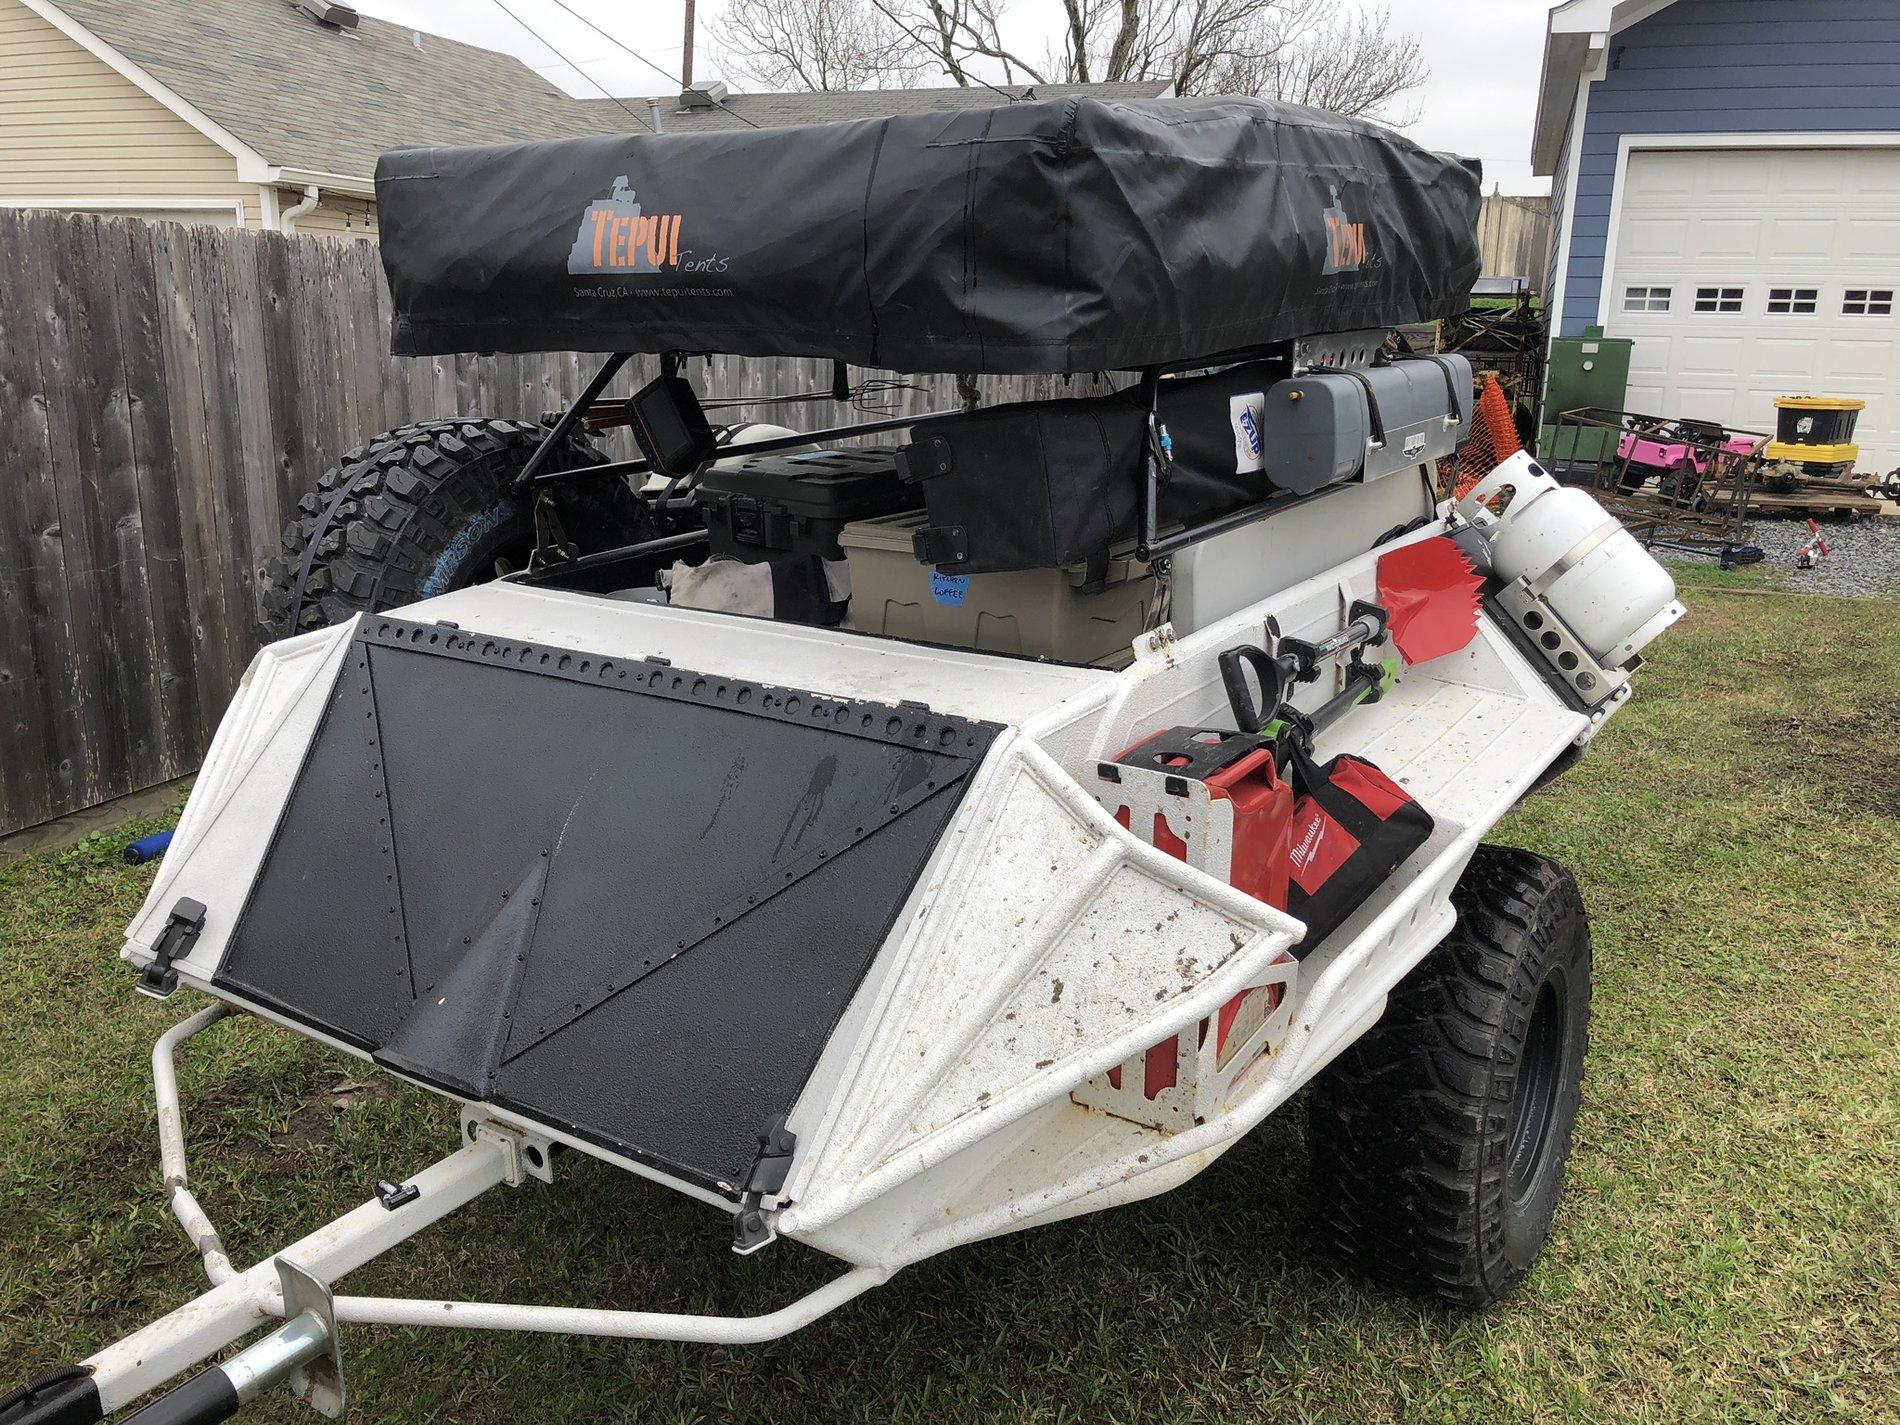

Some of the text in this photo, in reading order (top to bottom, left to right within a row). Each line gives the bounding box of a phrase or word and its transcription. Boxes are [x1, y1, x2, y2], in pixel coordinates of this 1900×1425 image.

[591, 210, 682, 267] TEPUI
[675, 250, 730, 273] Tents
[573, 286, 596, 298] Santa
[634, 286, 733, 299] www.tepuitents.com
